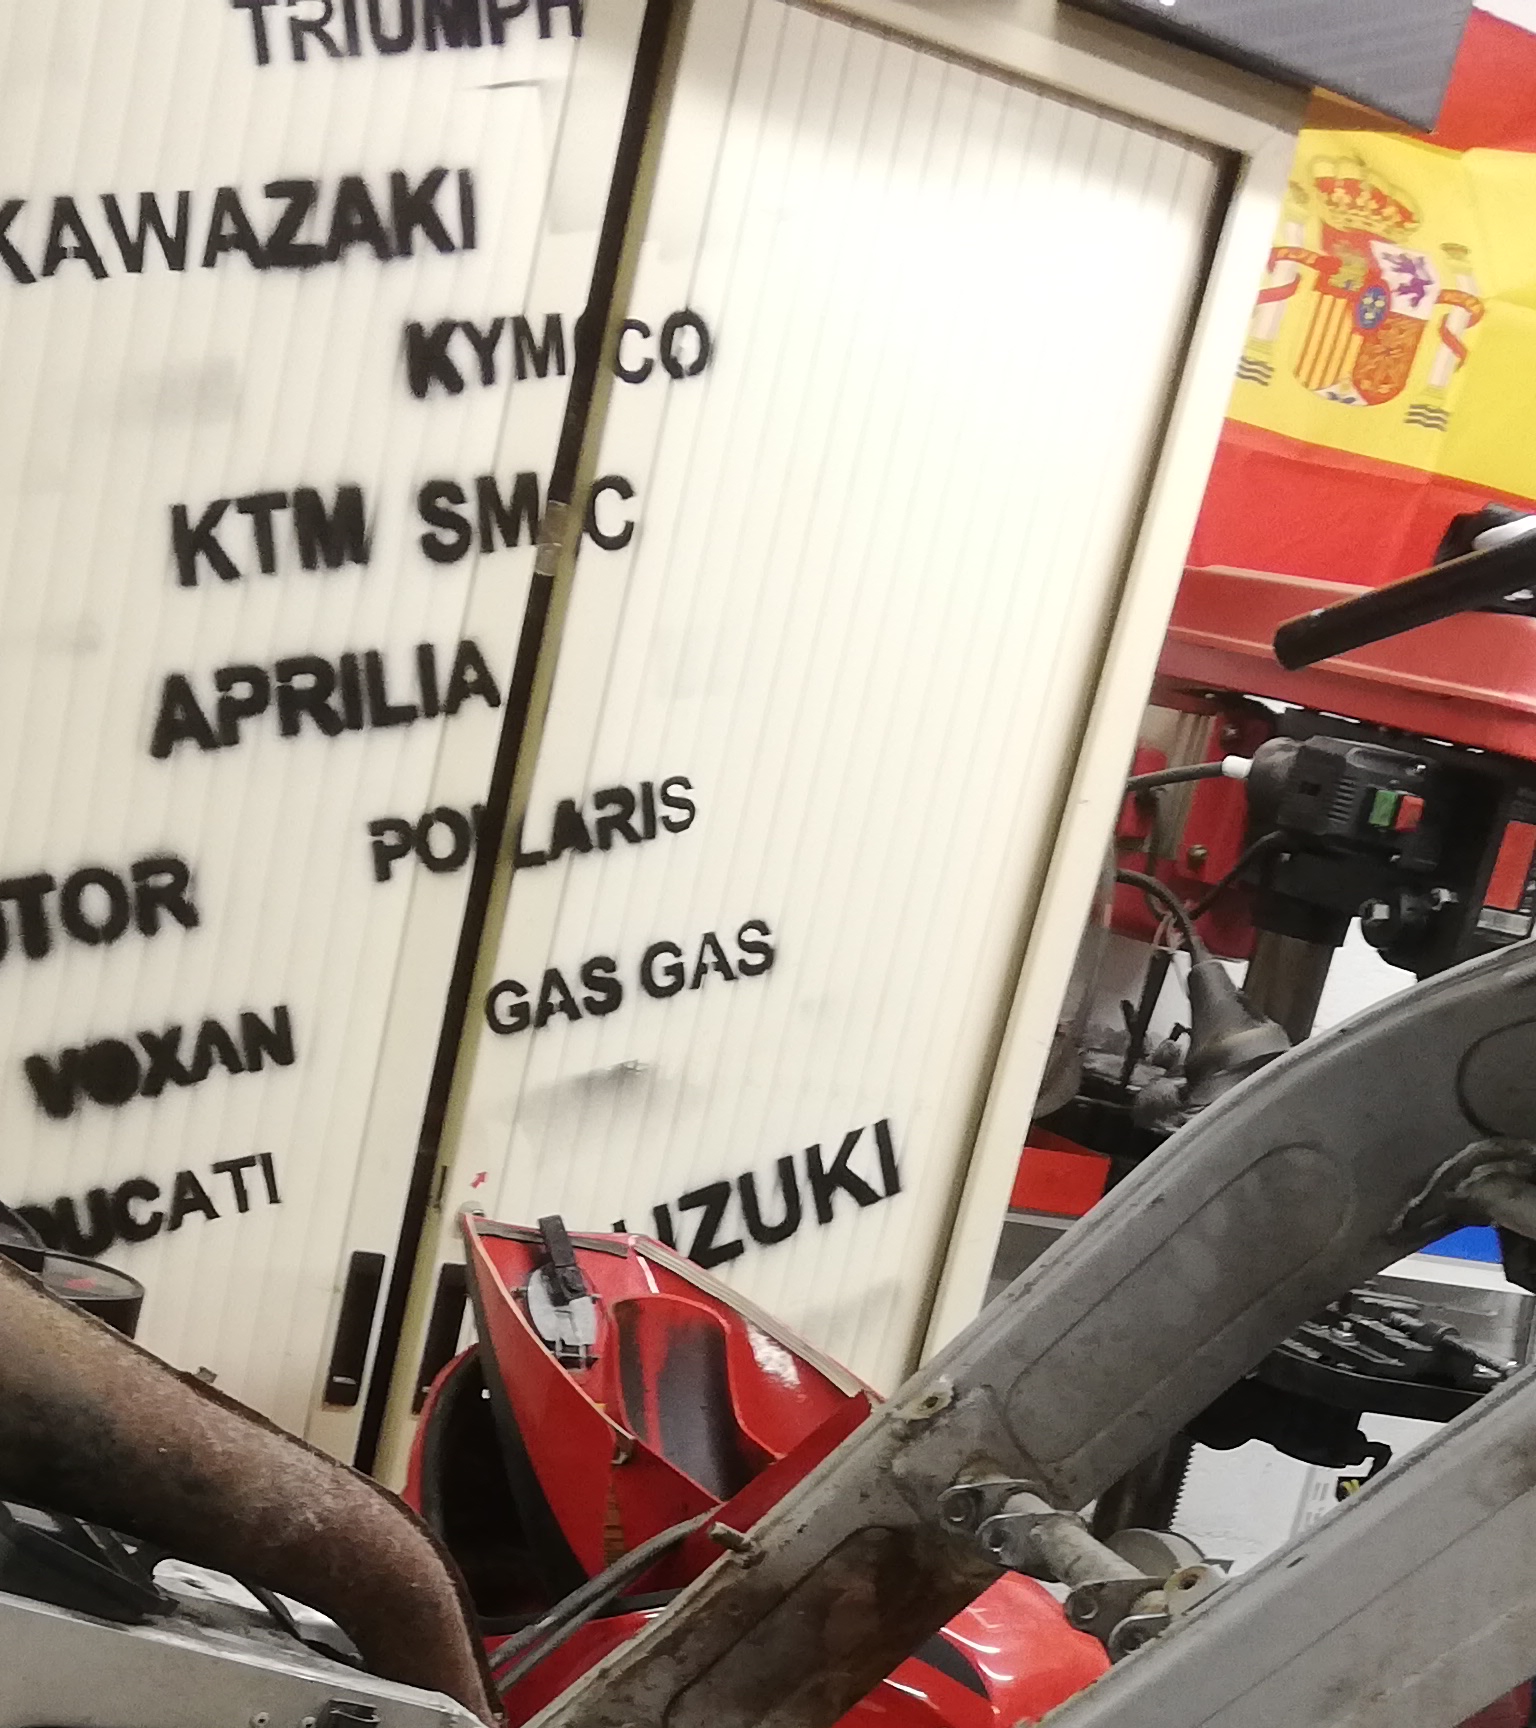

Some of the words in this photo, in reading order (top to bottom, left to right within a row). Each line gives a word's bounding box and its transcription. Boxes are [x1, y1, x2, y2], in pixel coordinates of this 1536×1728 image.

[231, 0, 585, 66] TRIUMPH
[170, 486, 373, 588] KTM
[149, 639, 502, 758] APRILIA
[368, 776, 696, 882] POLARIS
[483, 954, 623, 1035] GAS
[640, 919, 776, 999] GAS
[23, 1005, 296, 1120] VOXAN
